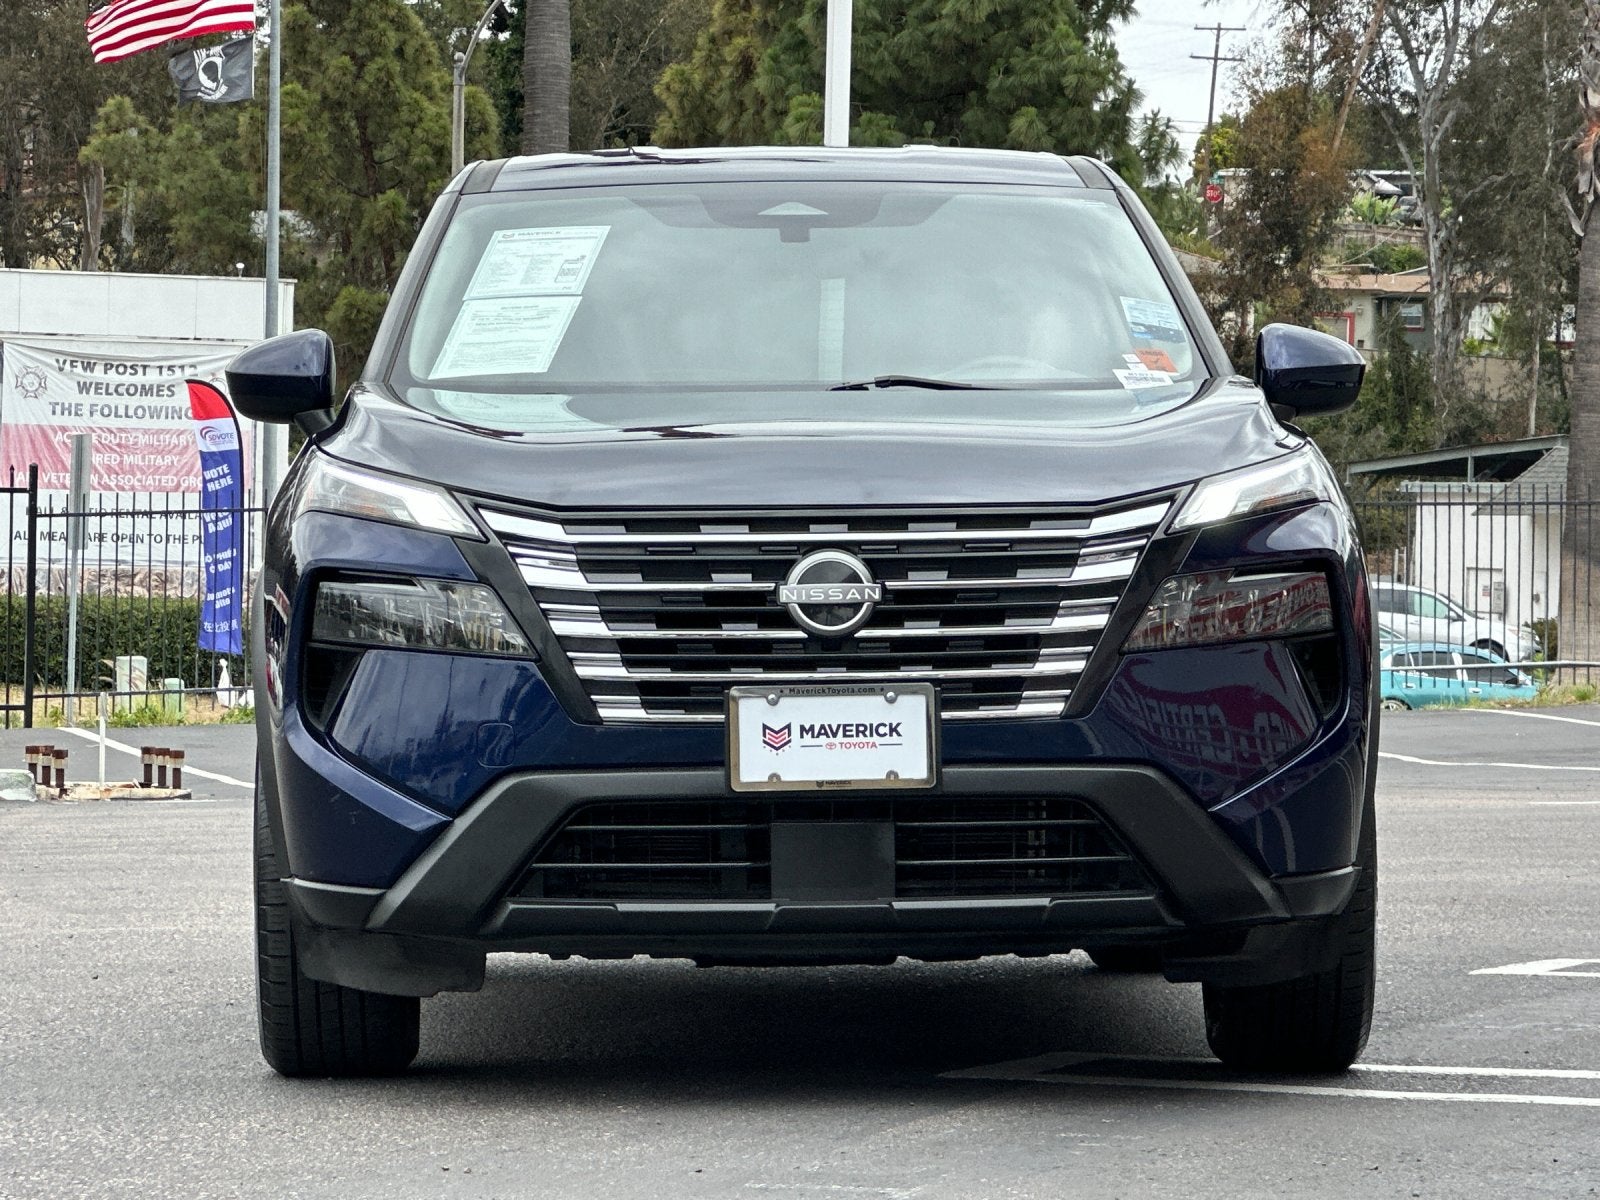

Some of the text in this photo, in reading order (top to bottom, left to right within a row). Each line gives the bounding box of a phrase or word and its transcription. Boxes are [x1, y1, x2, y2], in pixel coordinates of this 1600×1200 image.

[55, 358, 198, 377] VFW POST 1512
[76, 380, 175, 398] WELCOMES
[49, 401, 83, 417] THE
[55, 431, 97, 444] ACE
[102, 433, 135, 446] DUTY
[138, 434, 194, 446] MILITARY
[123, 454, 179, 467] MILITARY
[203, 463, 230, 480] VOTE
[42, 472, 99, 484] VETEN
[101, 474, 177, 487] ASSOCIATED
[206, 475, 234, 492] HERE
[111, 532, 144, 544] OPEN
[147, 534, 163, 545] TO
[166, 534, 189, 545] THE
[782, 587, 880, 602] NISSAN
[788, 686, 876, 696] MaverickToyota.com
[799, 722, 903, 739] MAVERICK
[838, 741, 878, 750] TOYOTA
